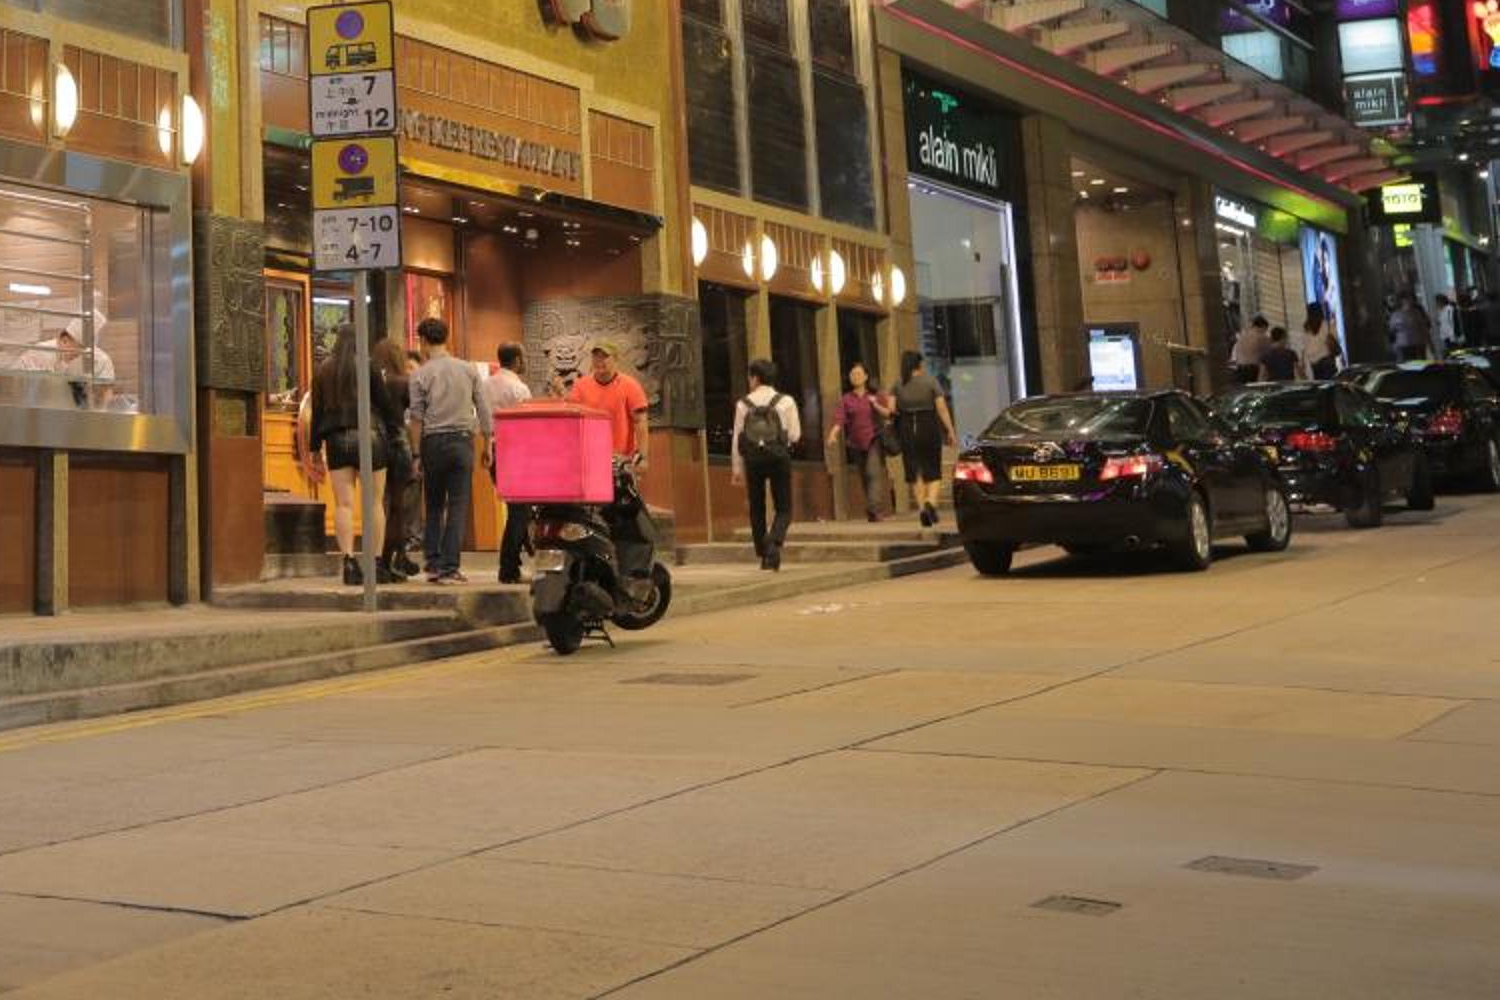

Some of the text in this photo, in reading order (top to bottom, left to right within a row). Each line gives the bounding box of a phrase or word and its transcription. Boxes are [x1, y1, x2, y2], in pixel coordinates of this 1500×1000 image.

[363, 75, 376, 96] 7
[364, 107, 390, 129] 12
[919, 124, 959, 175] alain
[347, 215, 393, 232] 7-10
[345, 243, 381, 260] 4-7
